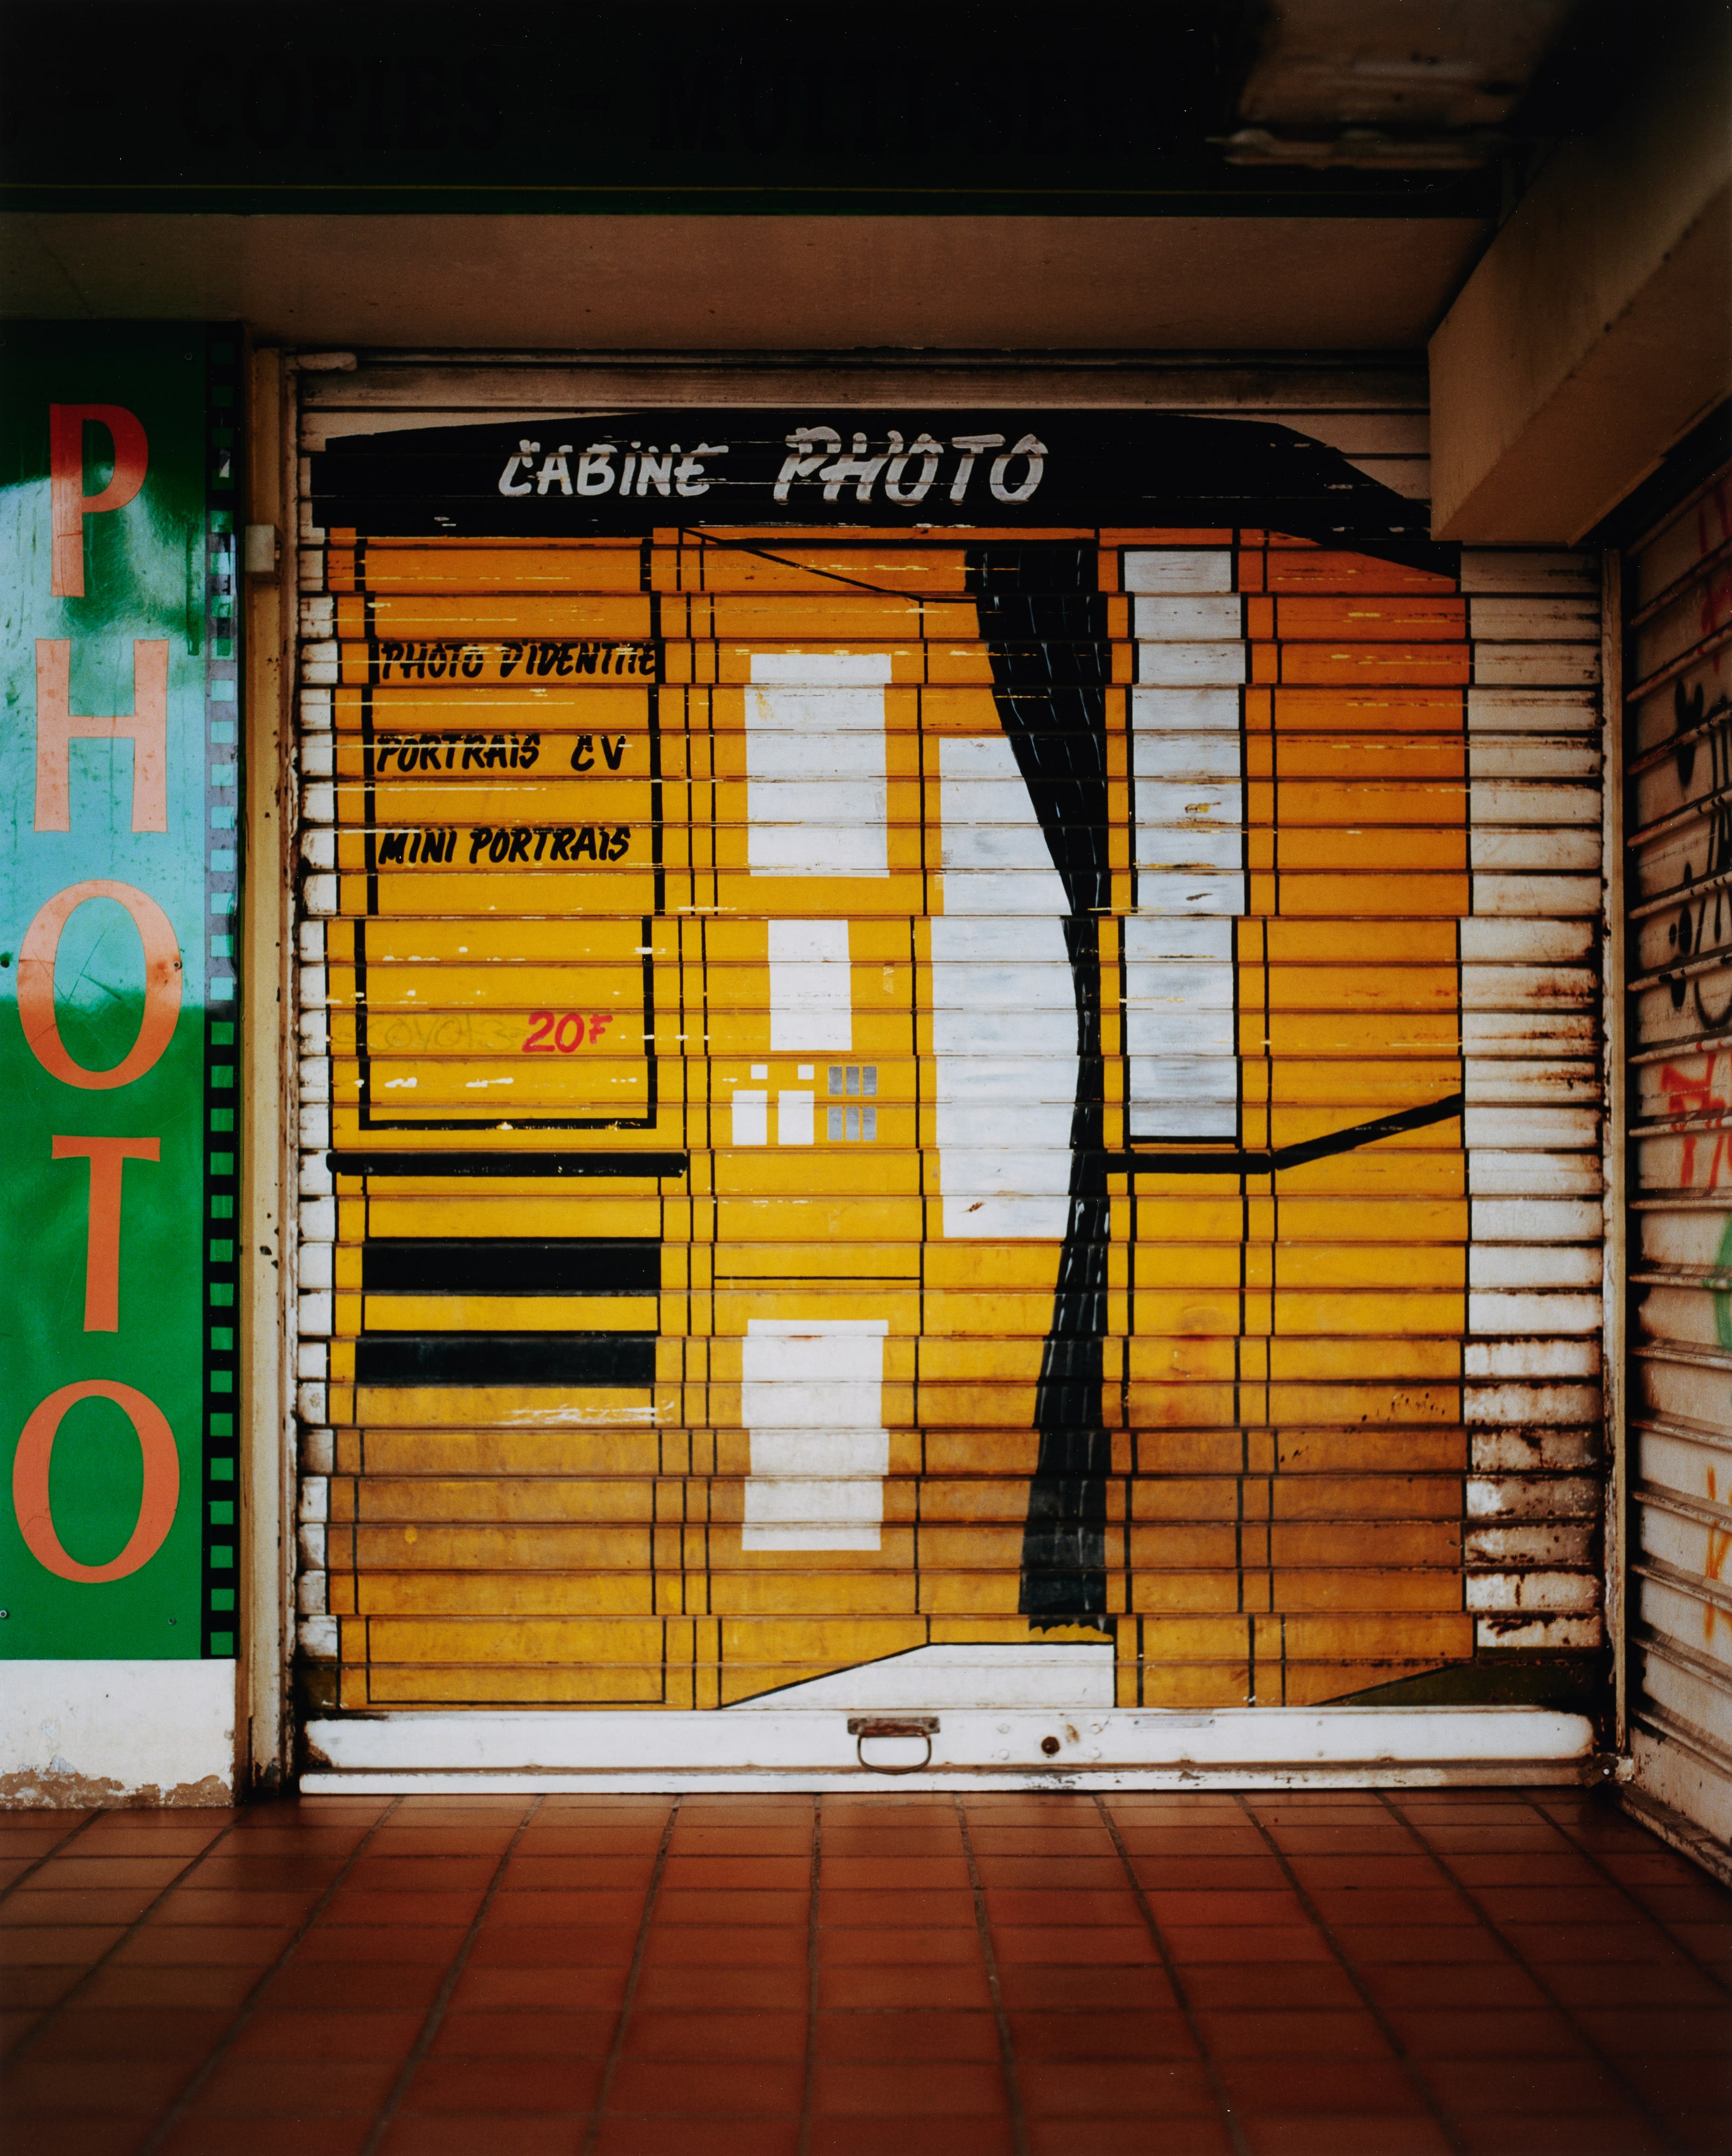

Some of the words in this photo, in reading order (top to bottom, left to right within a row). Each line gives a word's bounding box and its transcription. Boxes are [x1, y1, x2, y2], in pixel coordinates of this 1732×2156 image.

[180, 51, 505, 152] COPIES
[773, 426, 1049, 506] PHOTO
[381, 641, 484, 679] PHOTO
[377, 731, 541, 772] PORTRAIS
[570, 733, 626, 771] CV
[378, 825, 458, 864] MINI
[469, 825, 631, 864] PORTRAIS
[12, 403, 183, 1584] PHOTO
